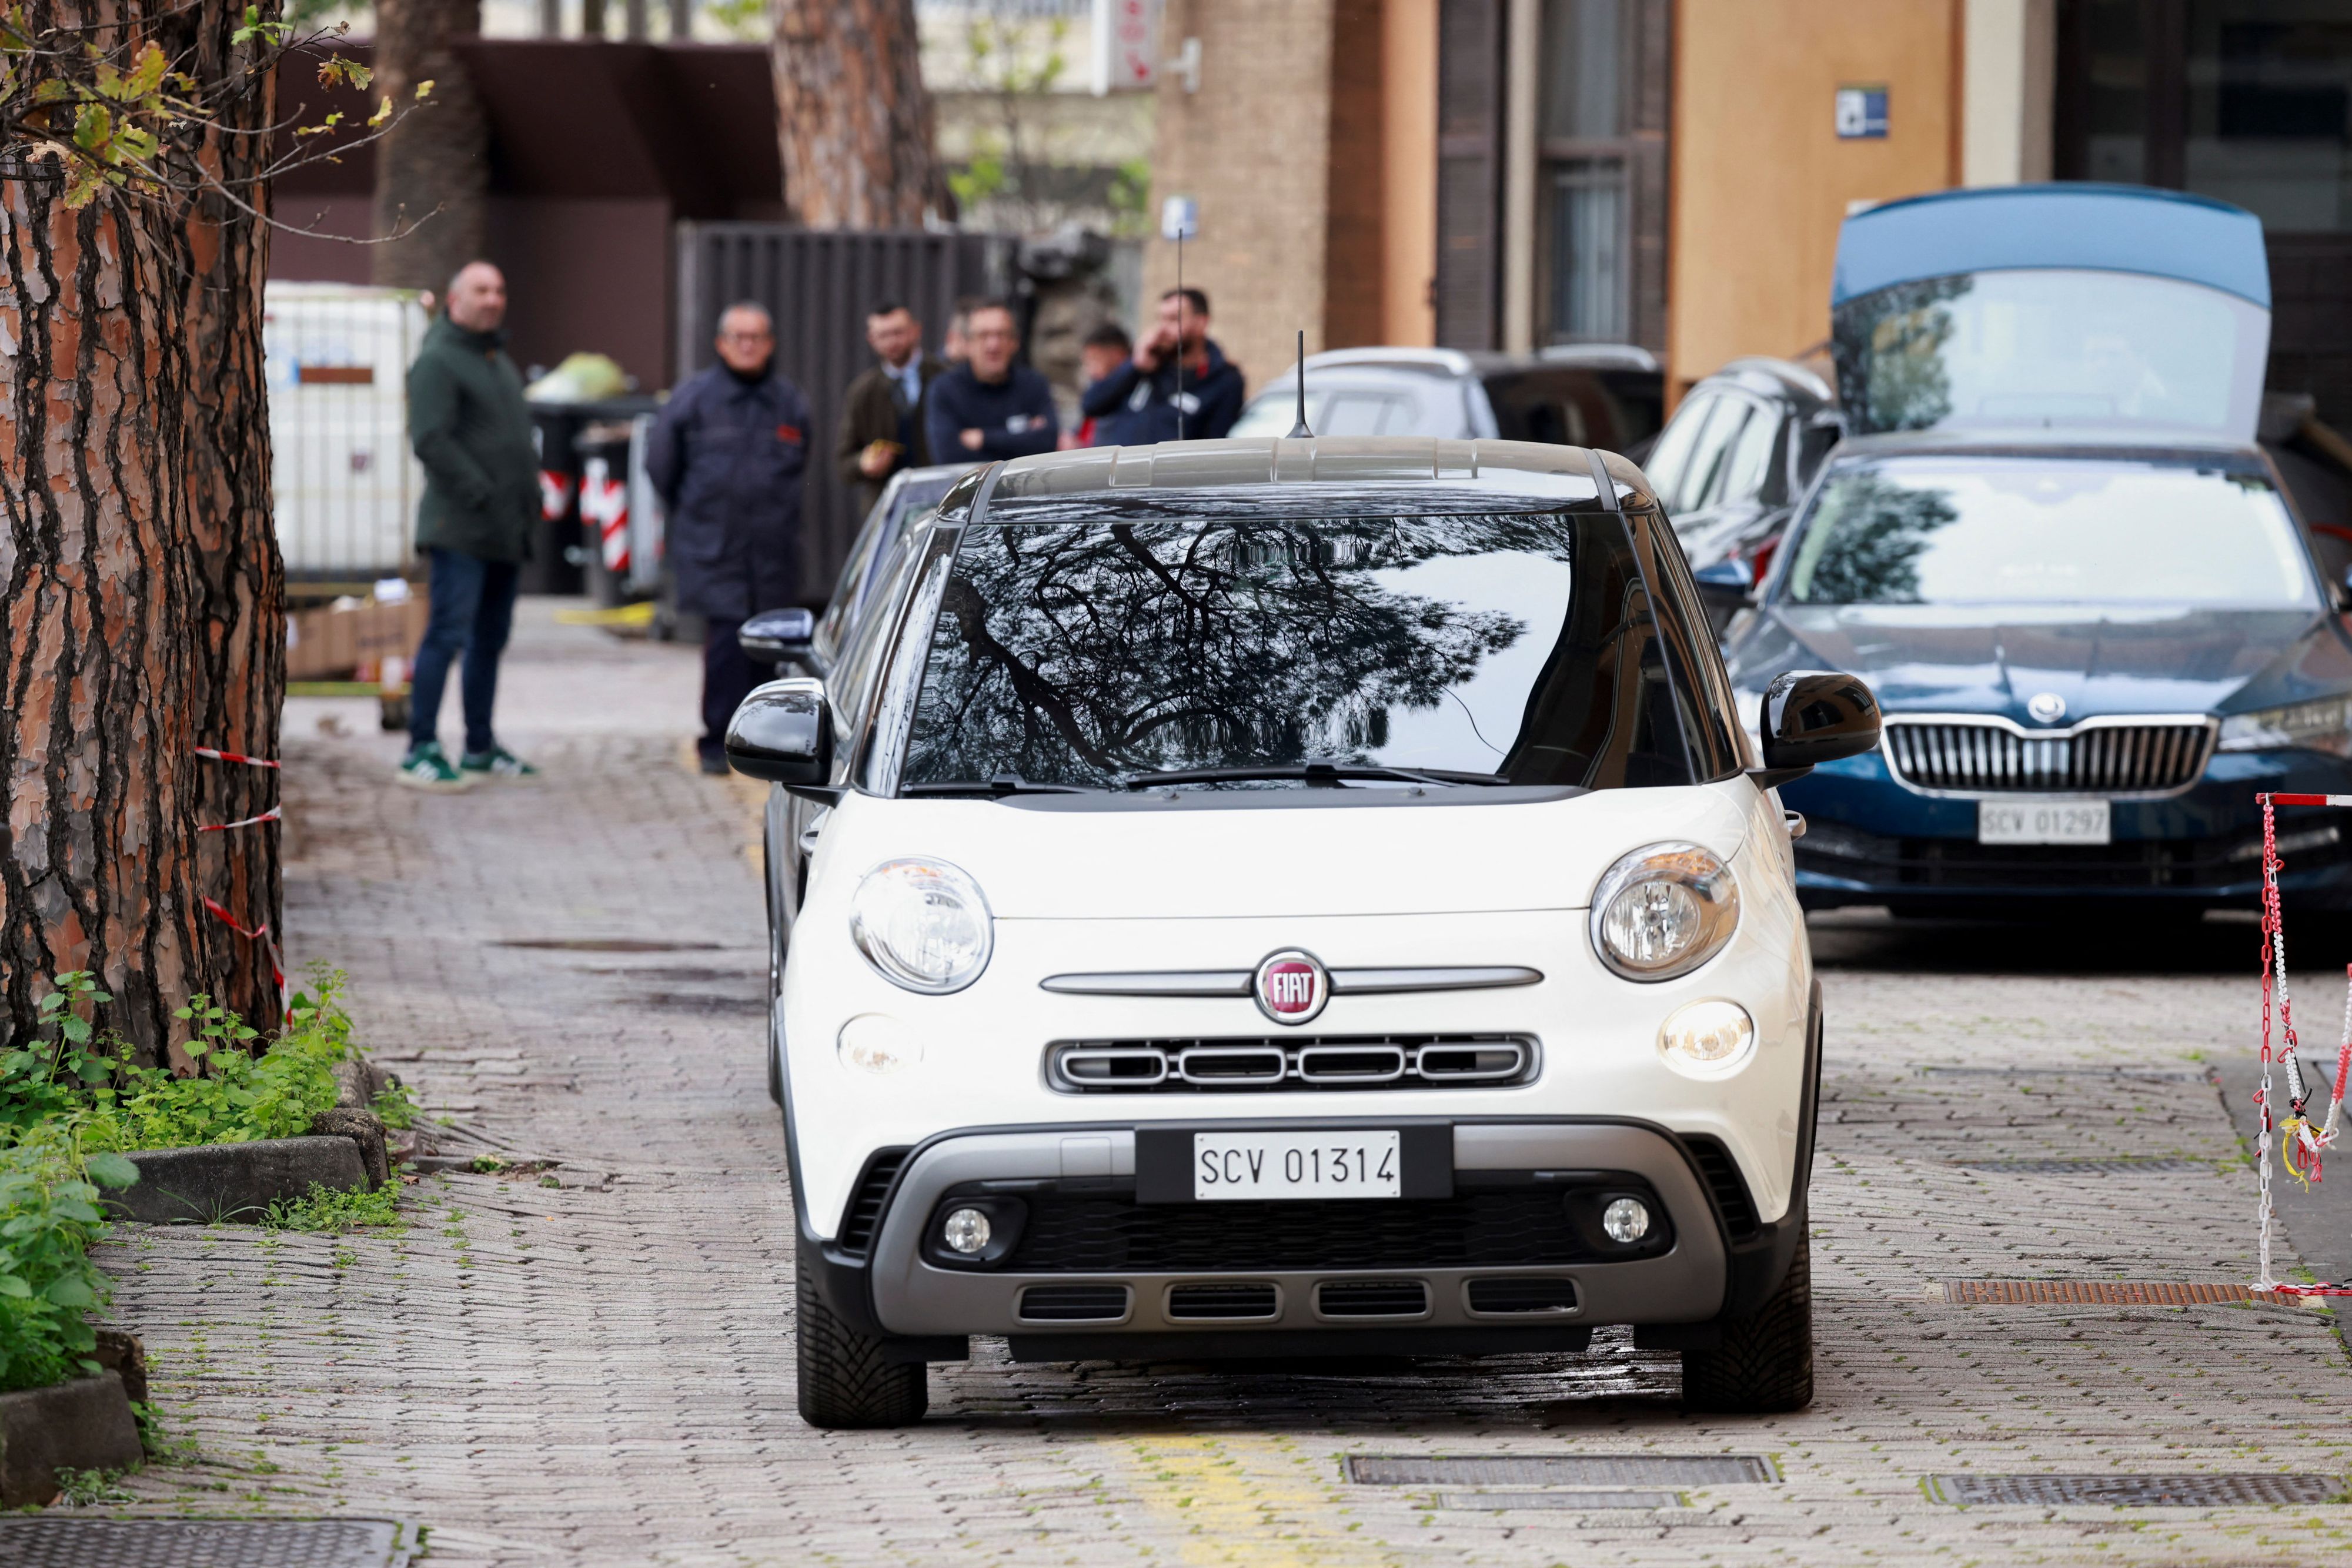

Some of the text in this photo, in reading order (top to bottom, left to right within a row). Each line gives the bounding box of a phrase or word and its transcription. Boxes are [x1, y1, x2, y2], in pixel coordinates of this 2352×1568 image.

[1984, 808, 2104, 835] SCV 01297
[1272, 972, 1312, 1003] FIAT
[1201, 1147, 1394, 1183] SCV 01314
